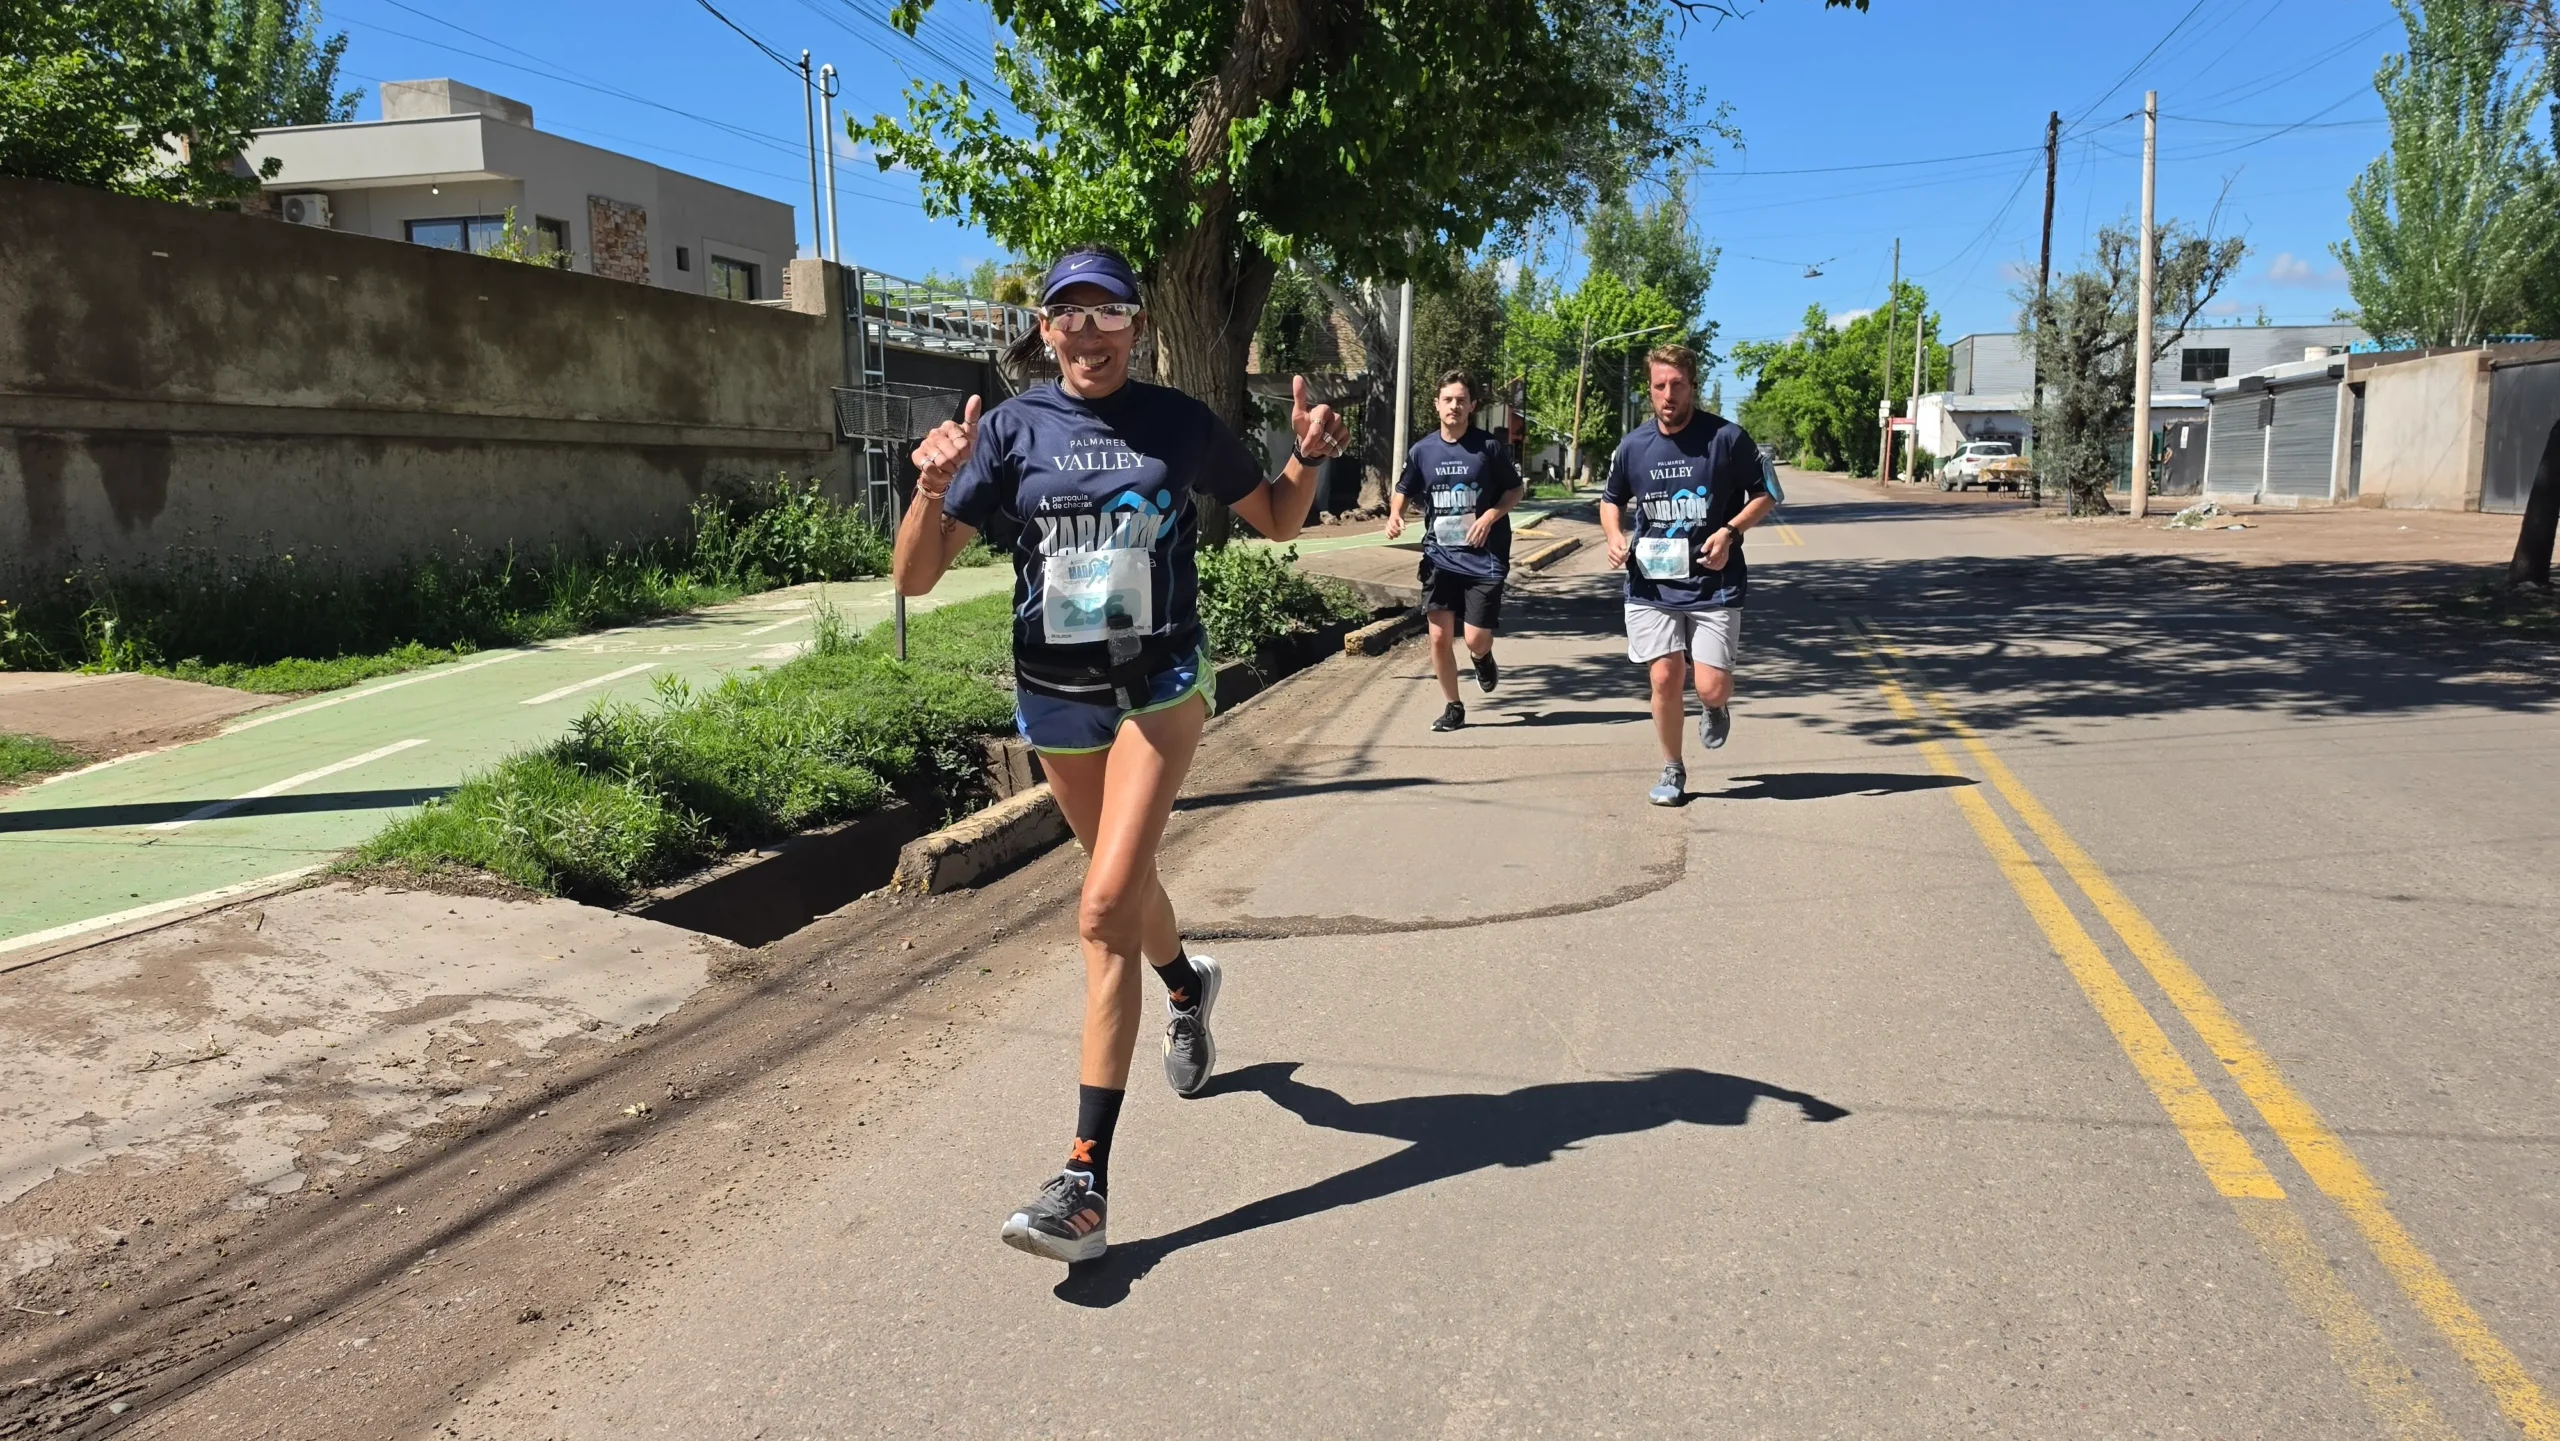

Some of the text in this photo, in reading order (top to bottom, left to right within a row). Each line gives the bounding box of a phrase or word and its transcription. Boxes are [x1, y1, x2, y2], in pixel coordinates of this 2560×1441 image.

[1070, 438, 1126, 448] PALMARES
[1053, 452, 1145, 471] VALLEY
[1435, 466, 1469, 475] VALLEY
[1650, 466, 1693, 480] VALLEY
[1052, 494, 1089, 503] parroquia
[1053, 501, 1093, 510] de chacras
[1060, 594, 1125, 627] 256
